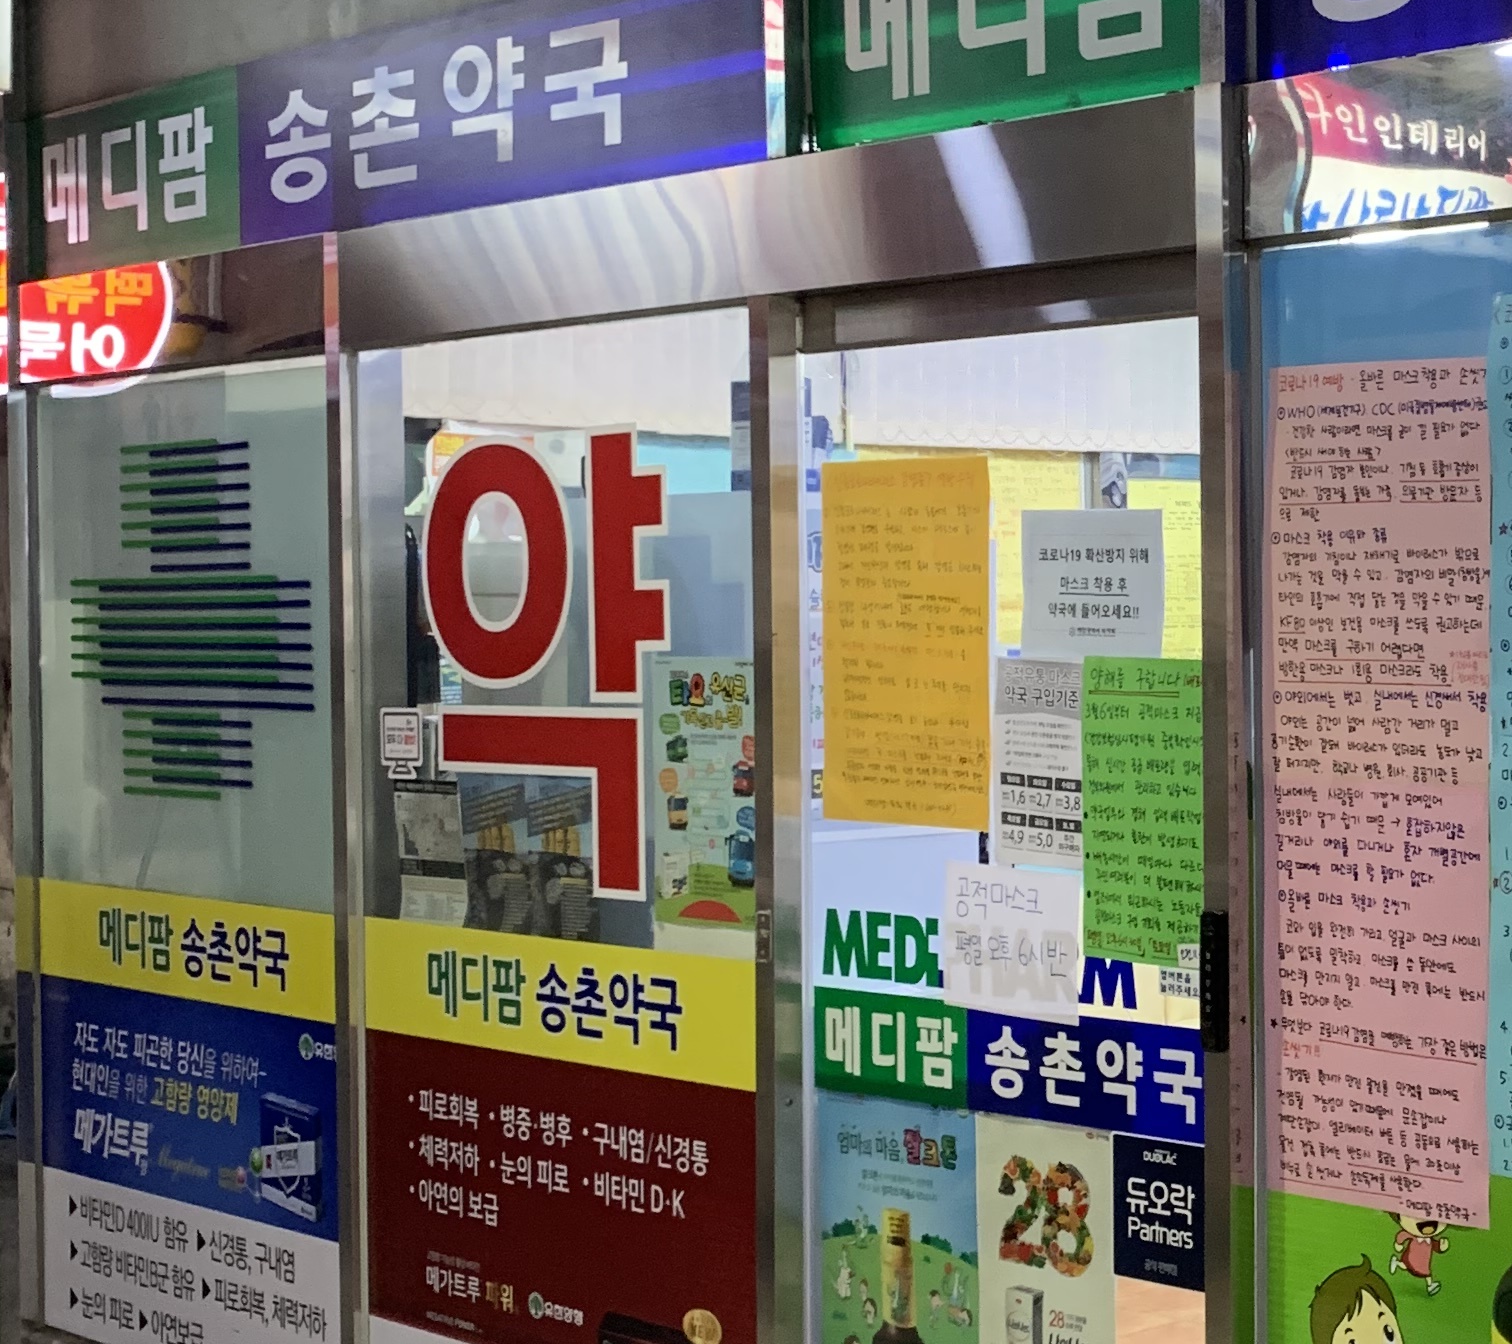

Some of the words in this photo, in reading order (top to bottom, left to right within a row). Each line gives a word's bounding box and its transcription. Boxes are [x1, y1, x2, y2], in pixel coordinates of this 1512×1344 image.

[265, 18, 629, 205] 송촌약국
[42, 106, 214, 244] 메디팜
[1359, 369, 1384, 392] 올바른
[1038, 548, 1081, 563] 코로나19
[1085, 548, 1125, 564] 확산방지
[1129, 548, 1149, 564] 위해
[1060, 576, 1089, 591] 마스크
[1093, 576, 1113, 592] 착용
[1117, 577, 1128, 592] 후
[1048, 603, 1077, 618] 약국에
[422, 423, 671, 902] 약
[1049, 667, 1081, 687] 마스크
[1090, 667, 1125, 690] 양해를
[1135, 667, 1180, 690] 구합니다
[1004, 685, 1028, 706] 약국
[1031, 688, 1079, 709] 구입기준
[956, 876, 1043, 920] 공적마스크
[98, 907, 174, 973] 메디팜
[180, 917, 290, 994] 송촌약국
[955, 930, 984, 967] 평일
[987, 933, 1013, 971] 오후
[427, 950, 526, 1026] 메디팜
[535, 961, 684, 1052] 송촌약국
[133, 1030, 174, 1071] 피곤한
[177, 1040, 216, 1079] 당신을
[824, 1005, 958, 1090] 메디팜
[984, 1025, 1203, 1127] 송촌약국
[71, 1057, 121, 1099] 현대인을
[125, 1070, 148, 1106] 위한
[150, 1076, 193, 1116] 고함량
[196, 1086, 238, 1126] 영양제
[418, 1089, 480, 1129] 피로회복
[74, 1107, 150, 1168] 메가트루
[418, 1133, 480, 1176] 체력저하
[500, 1151, 533, 1190] 눈의
[536, 1158, 570, 1194] 피로
[593, 1171, 645, 1215] 비타민
[418, 1179, 465, 1220] 아연의
[467, 1190, 499, 1228] 보급
[999, 1155, 1095, 1278] 28
[1125, 1176, 1196, 1226] 듀오락
[164, 1216, 188, 1254] 함유
[255, 1240, 296, 1284] 구내염
[1127, 1216, 1194, 1250] Partners
[80, 1239, 114, 1279] 고함량
[171, 1264, 196, 1303] 함유
[272, 1292, 328, 1343] 체력저하
[80, 1284, 108, 1320] 눈의
[110, 1295, 135, 1331] 피로
[426, 1265, 482, 1304] 메가트루
[485, 1281, 514, 1313] 파워
[544, 1301, 584, 1327] 유한양행
[1049, 1309, 1065, 1329] 28
